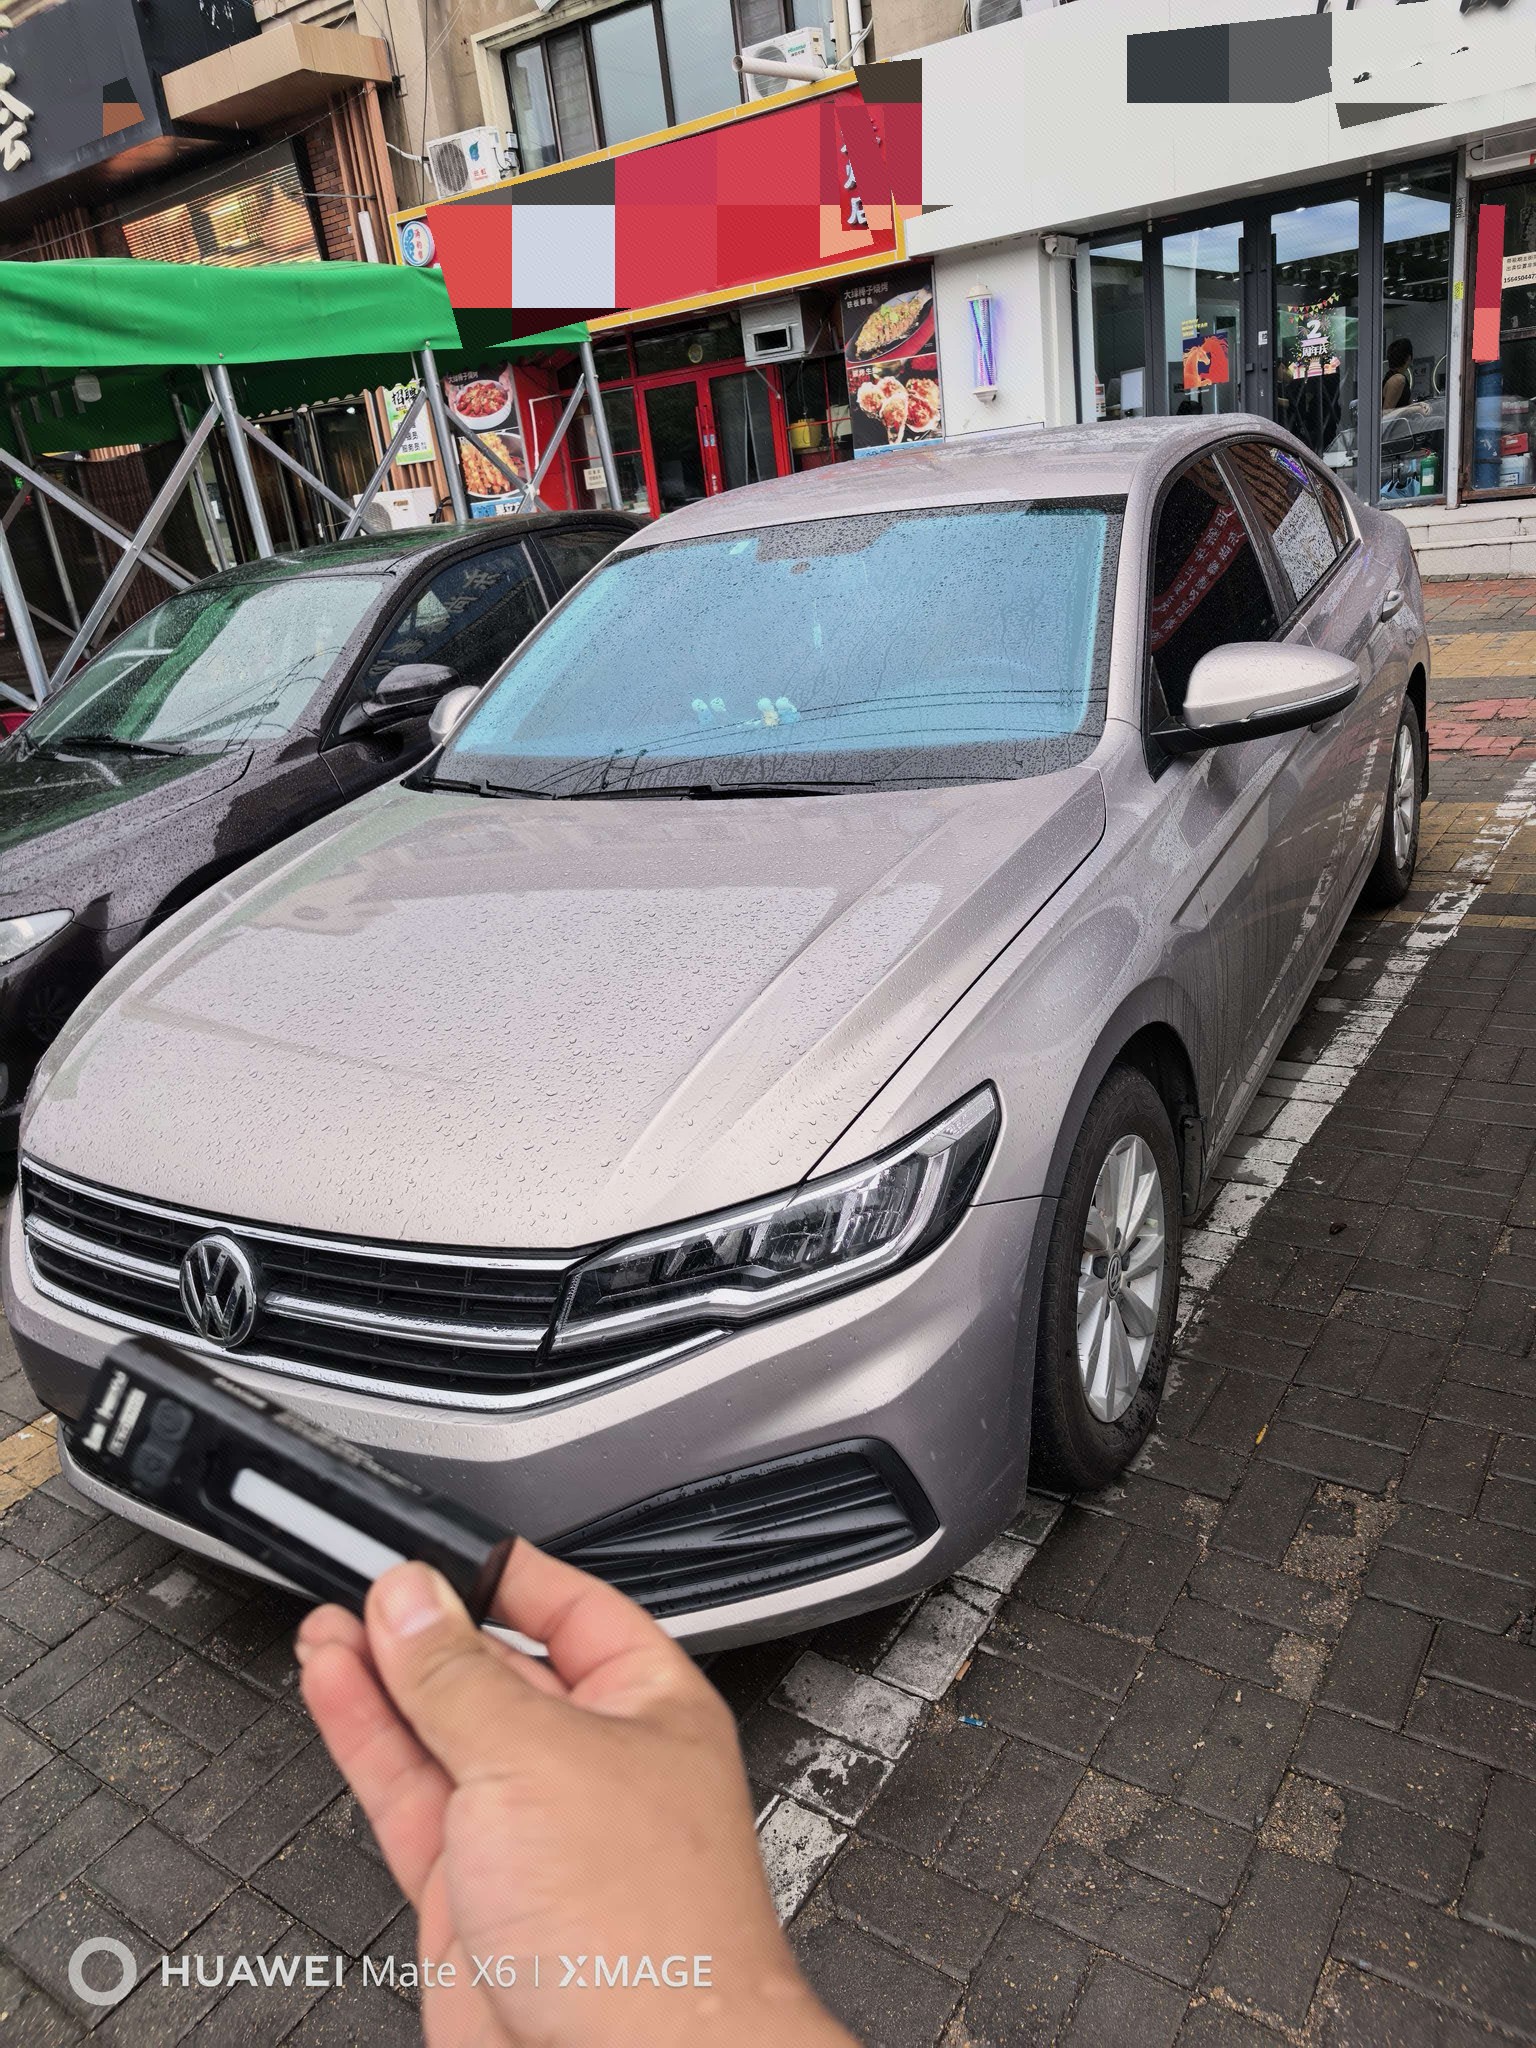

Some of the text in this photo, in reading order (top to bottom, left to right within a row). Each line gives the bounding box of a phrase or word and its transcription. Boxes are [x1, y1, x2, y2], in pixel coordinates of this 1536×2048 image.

[1307, 319, 1321, 339] 2
[1302, 344, 1328, 358] 周年庆
[391, 386, 418, 405] 招聘
